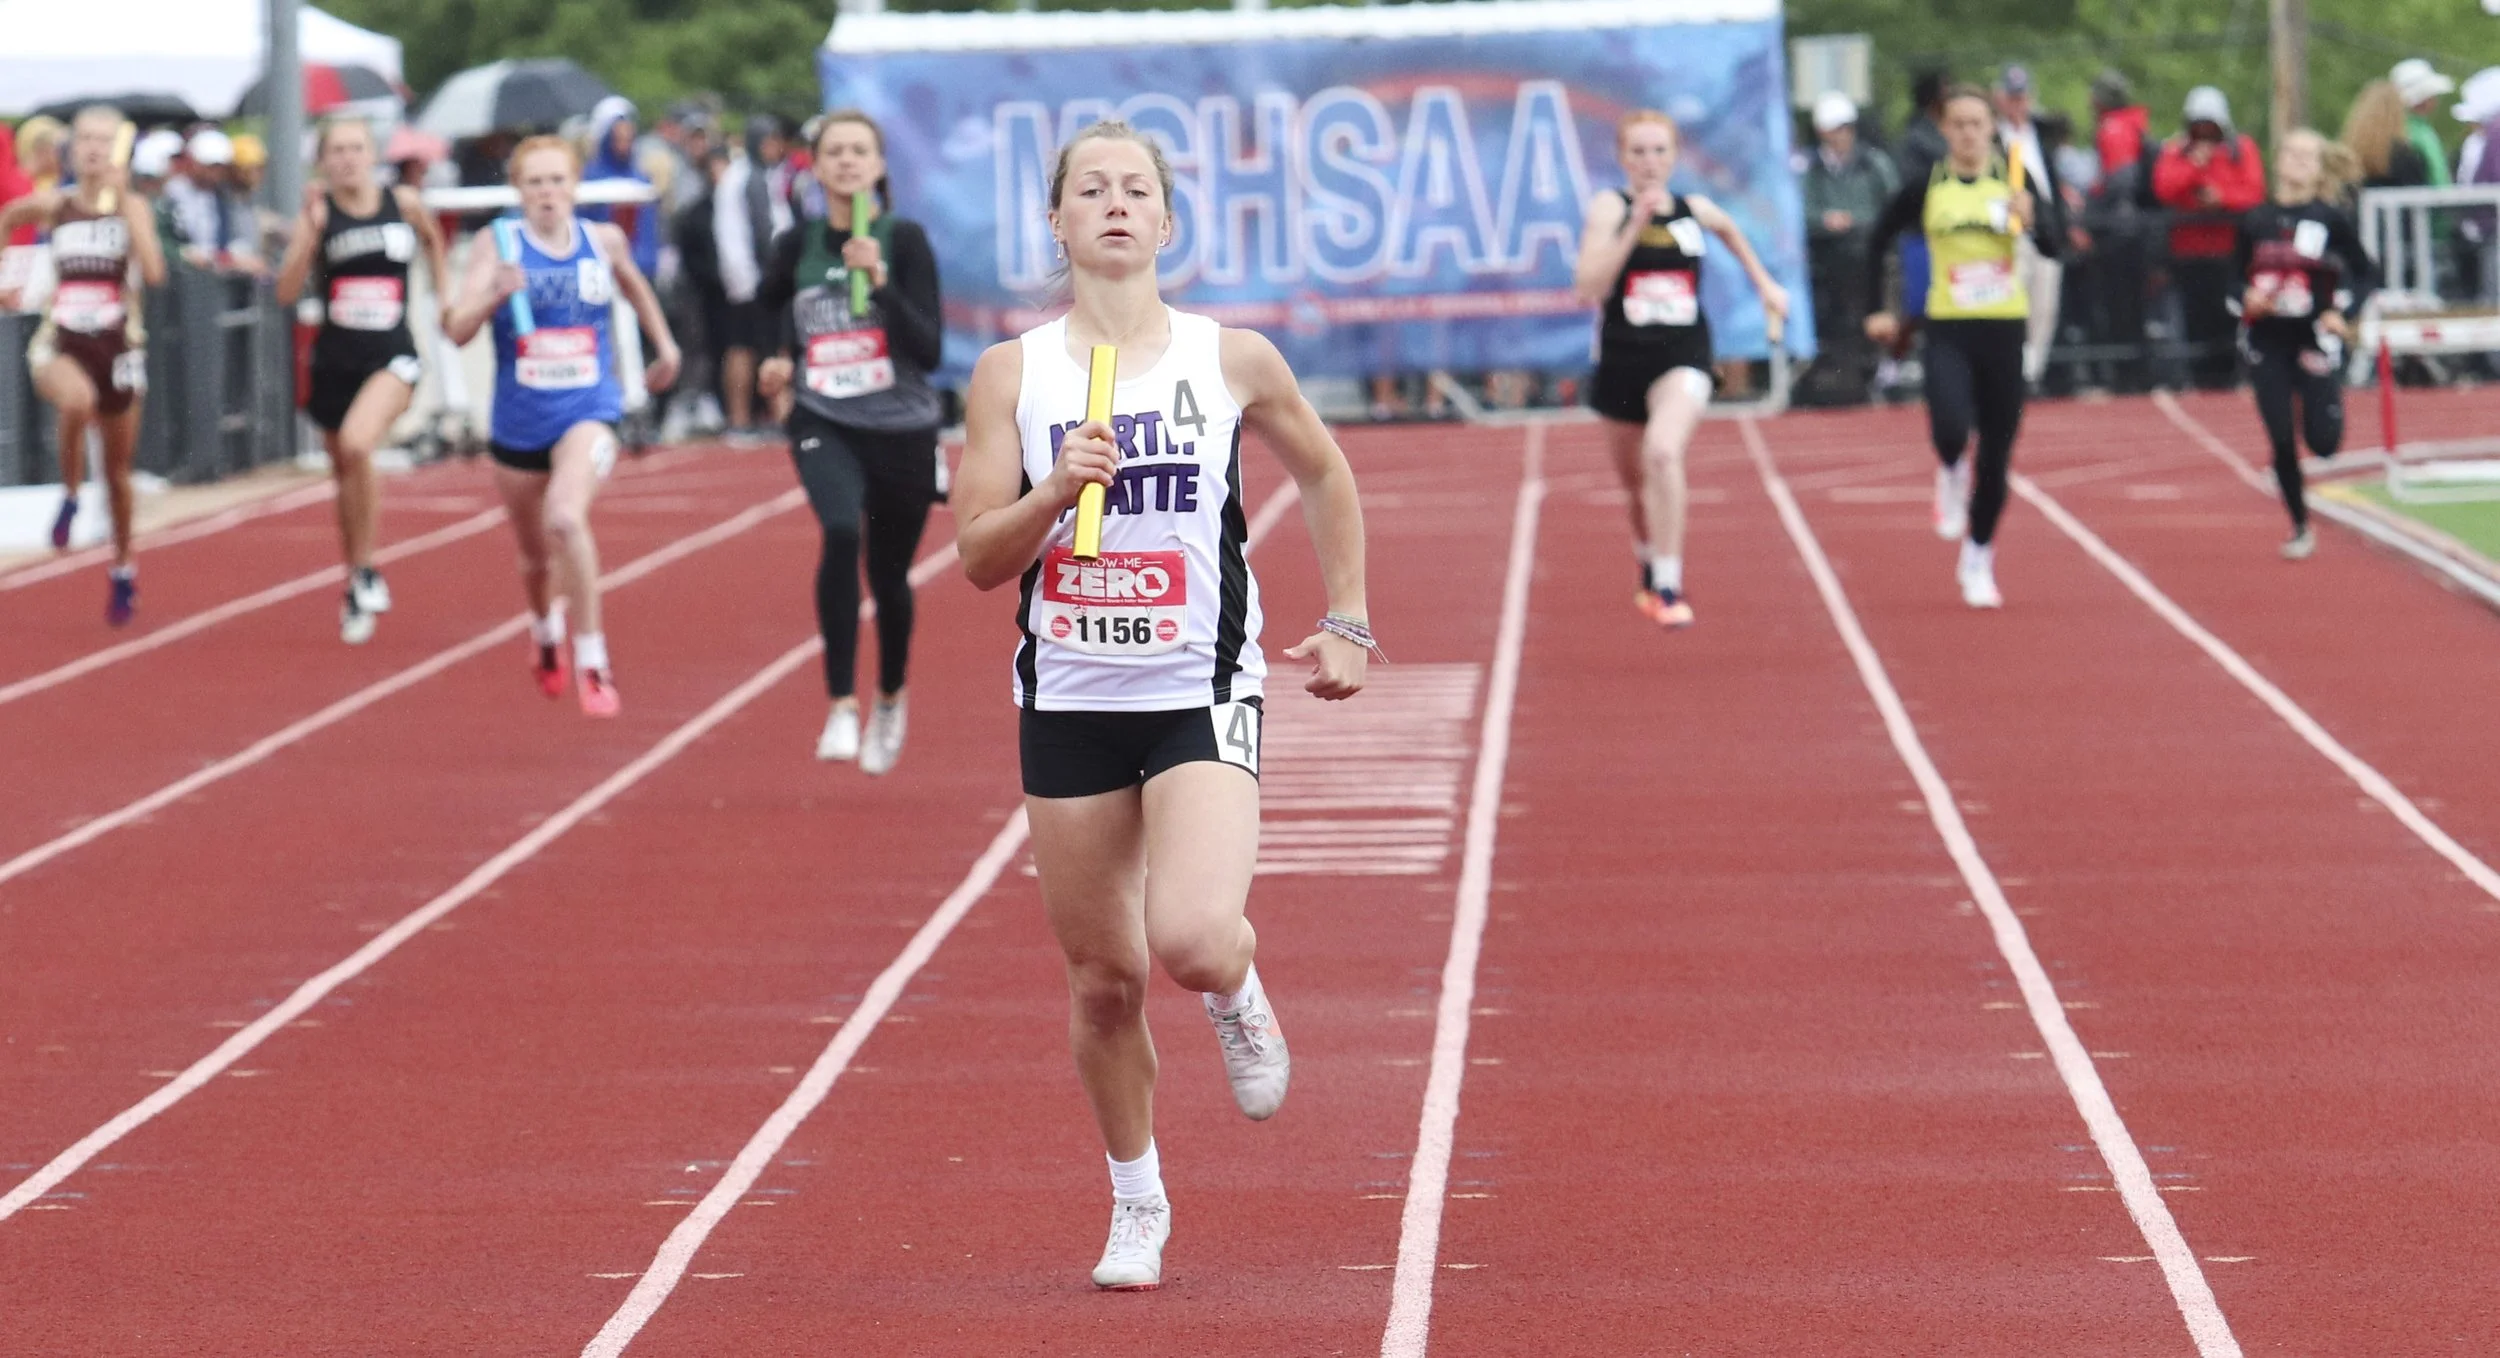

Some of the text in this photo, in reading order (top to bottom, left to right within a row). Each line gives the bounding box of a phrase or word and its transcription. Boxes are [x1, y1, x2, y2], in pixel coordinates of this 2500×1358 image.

[1174, 379, 1207, 436] 4
[1050, 411, 1195, 466] NRT
[1058, 463, 1200, 523] ATTE
[1057, 563, 1170, 598] ZERO
[1076, 615, 1151, 644] 1156
[1226, 705, 1253, 764] 4
